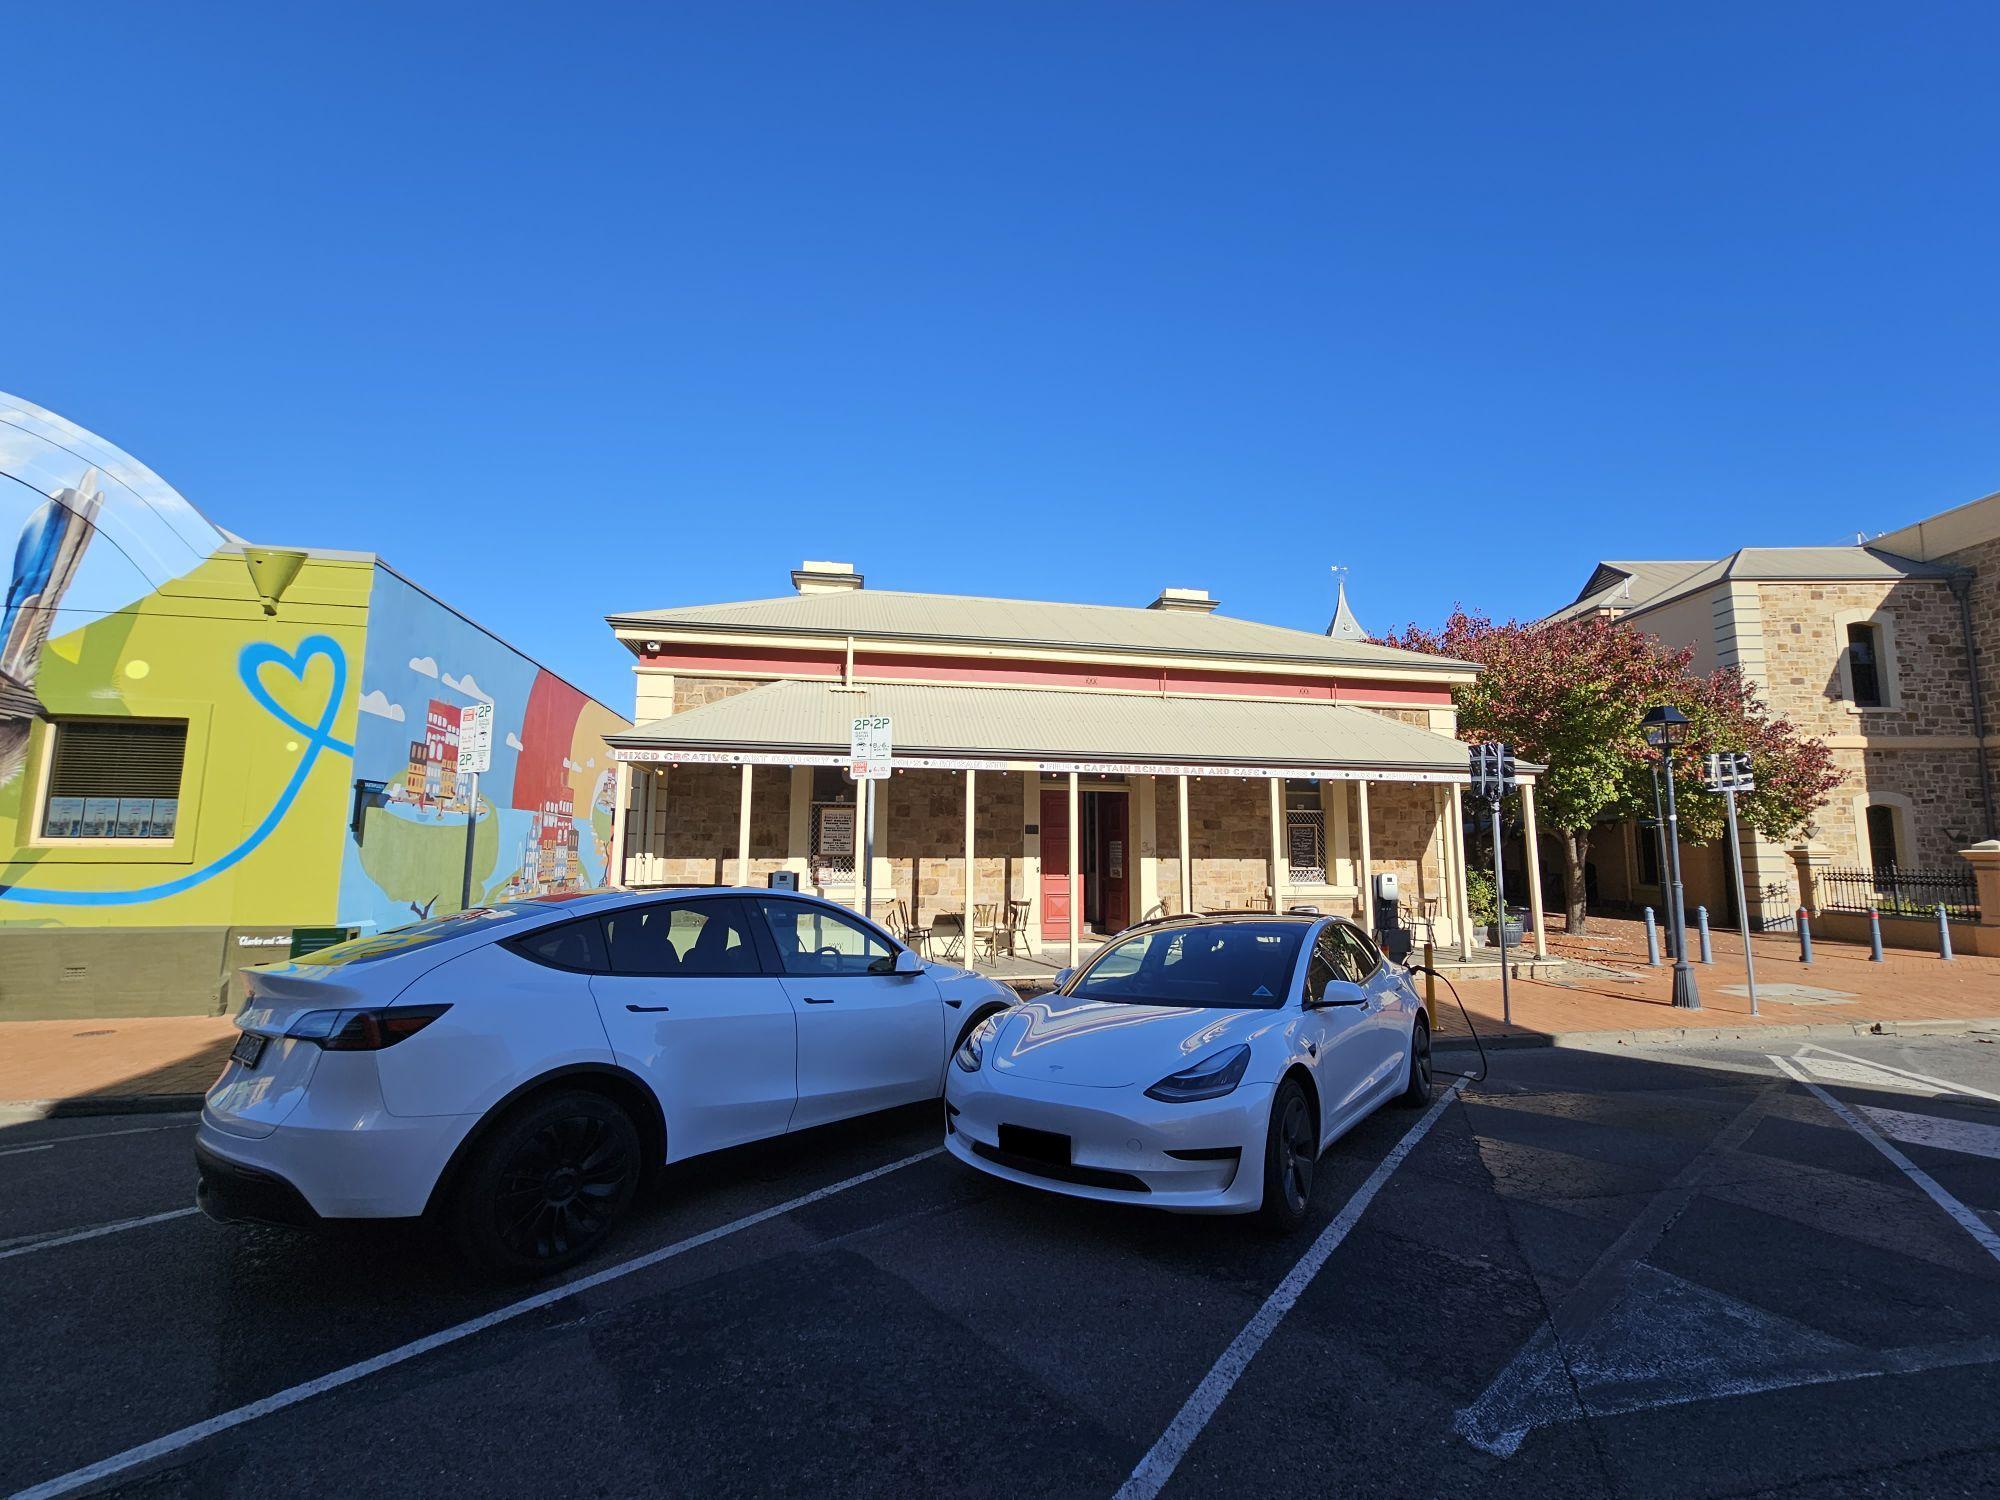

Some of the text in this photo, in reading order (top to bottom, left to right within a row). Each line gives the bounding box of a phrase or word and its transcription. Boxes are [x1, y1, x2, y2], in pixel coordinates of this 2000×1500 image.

[478, 706, 492, 718] 2P
[854, 719, 870, 730] 2P
[873, 718, 890, 729] 2P
[459, 754, 472, 766] 2P
[617, 751, 729, 761] MIXED CREATIVE
[741, 754, 768, 763] ART
[1083, 764, 1131, 772] CAPTAIN
[1134, 765, 1180, 774] REHAB'S
[1183, 767, 1205, 775] BAR
